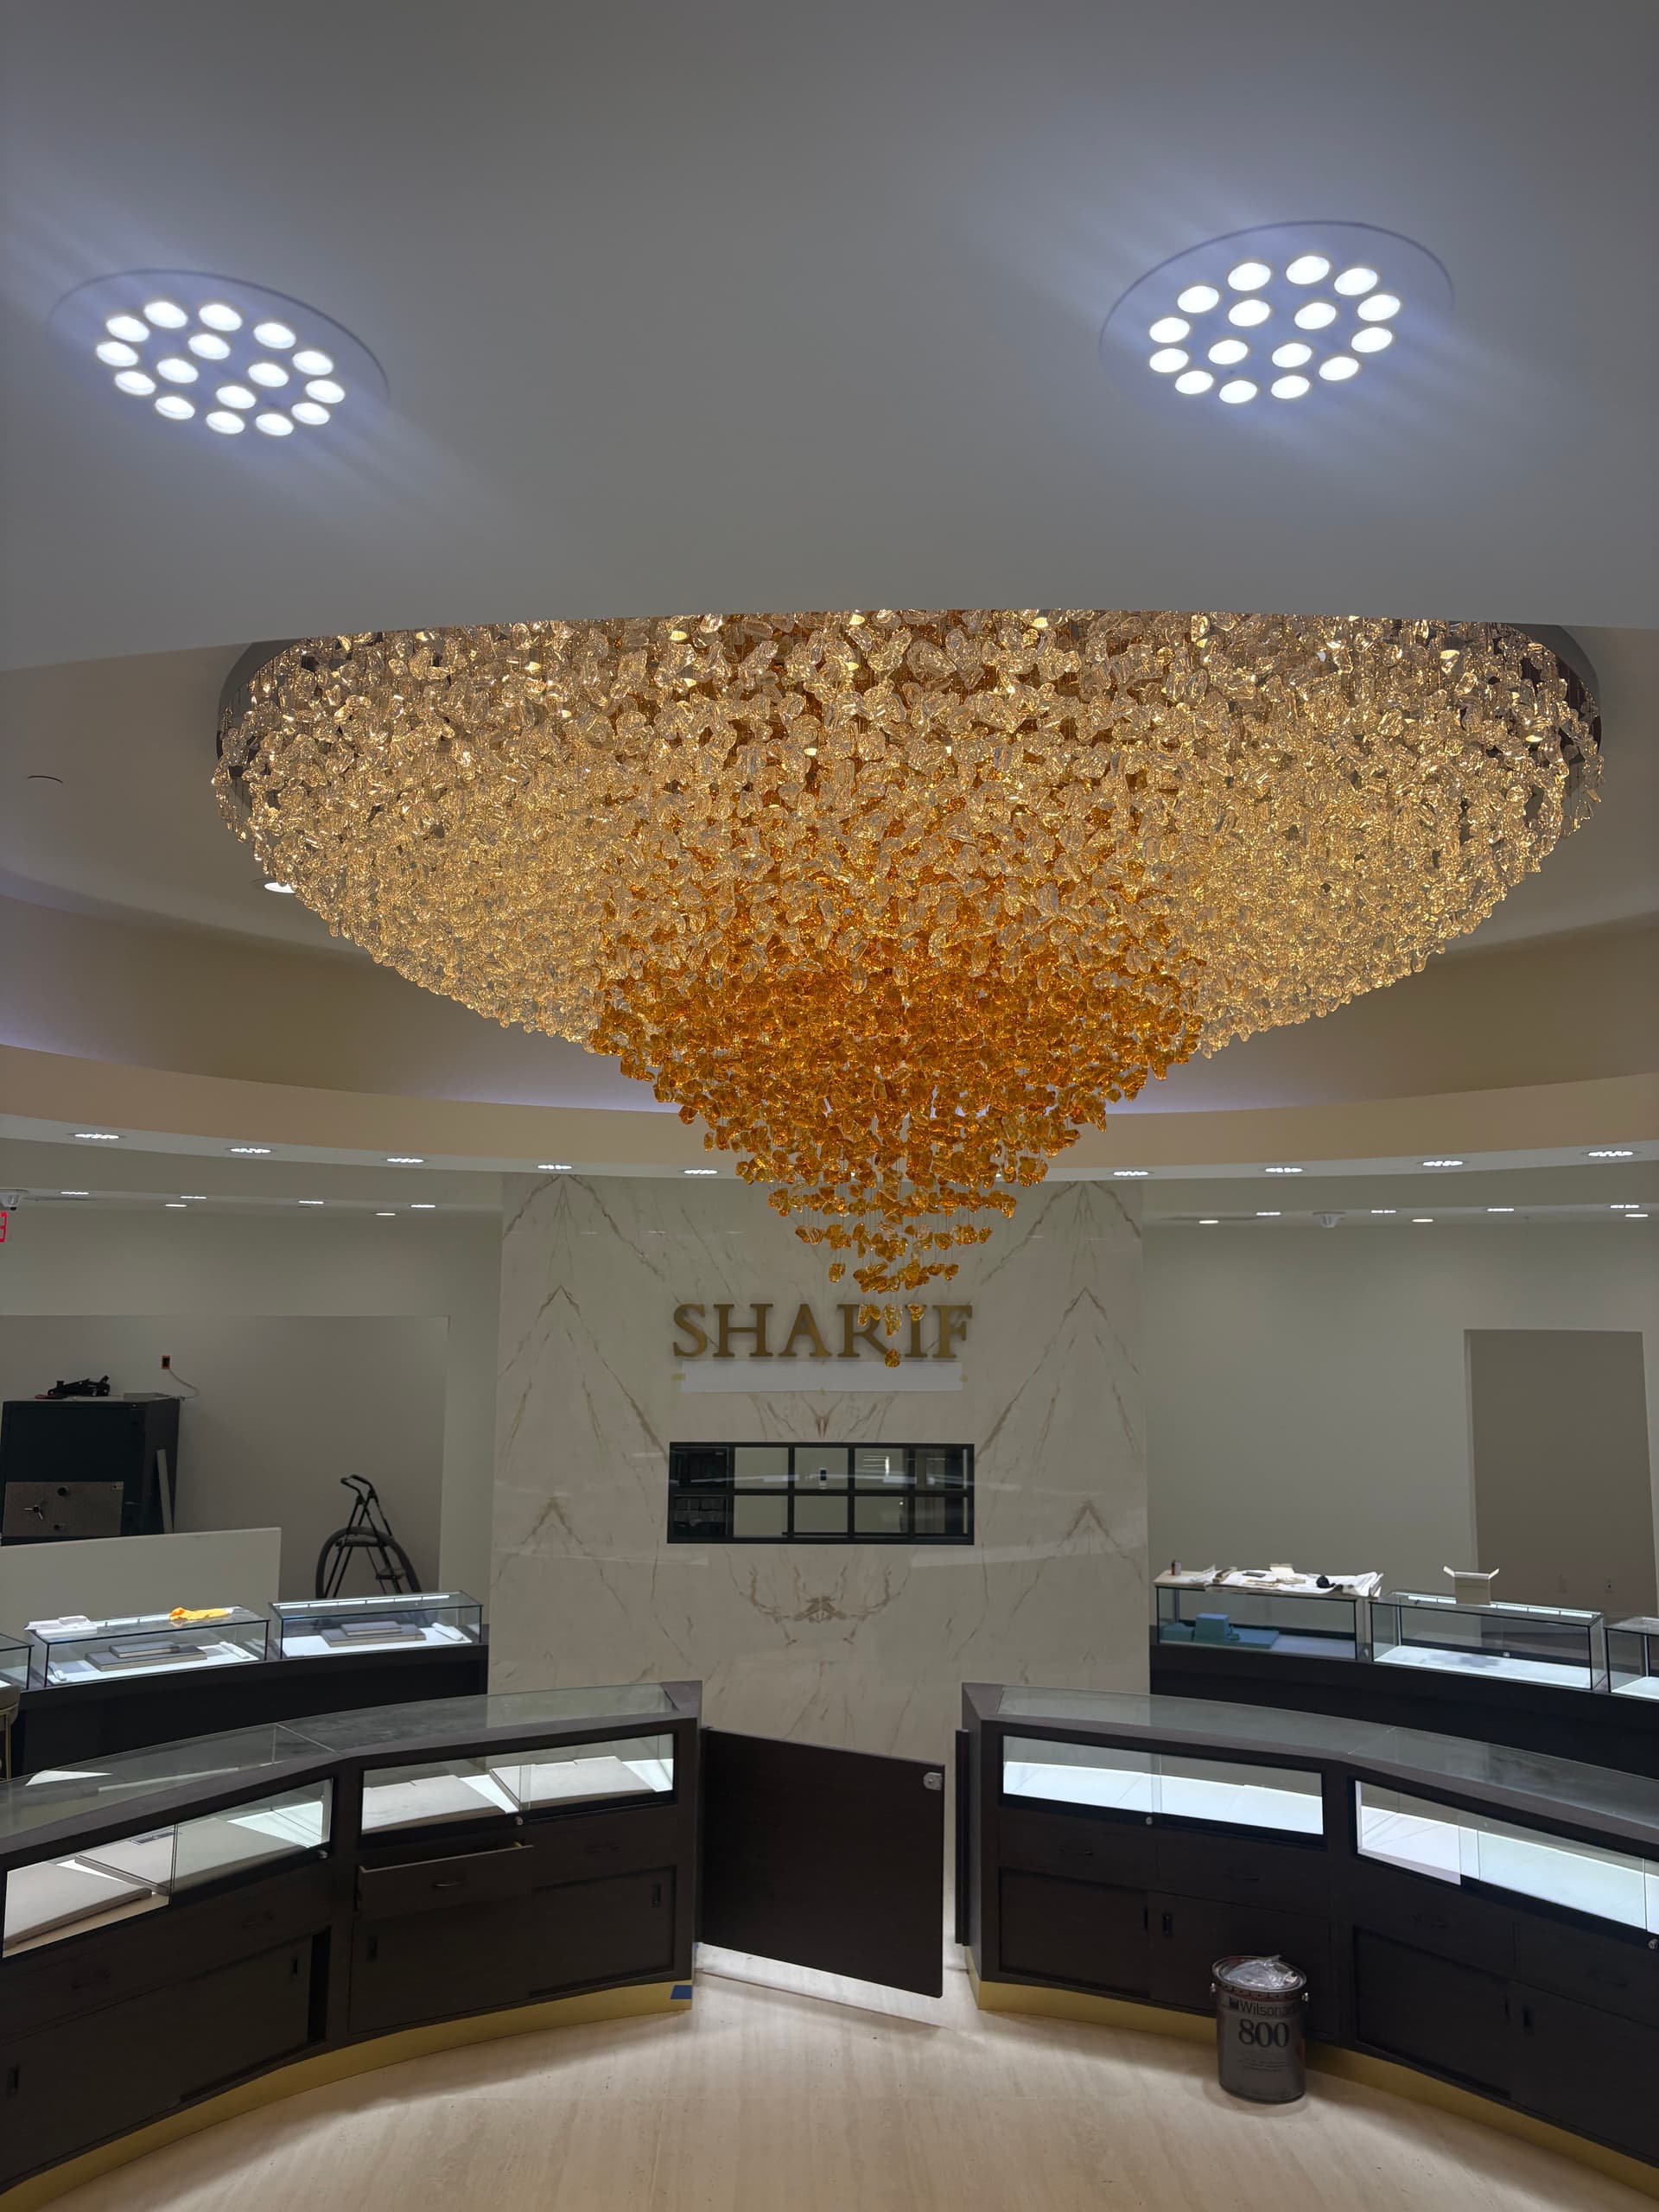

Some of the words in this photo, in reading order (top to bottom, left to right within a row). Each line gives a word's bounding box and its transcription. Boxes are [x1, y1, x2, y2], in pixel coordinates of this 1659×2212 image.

[672, 1303, 973, 1358] SHARIF
[1240, 1999, 1291, 2018] Wilson
[1239, 2018, 1289, 2047] 800
